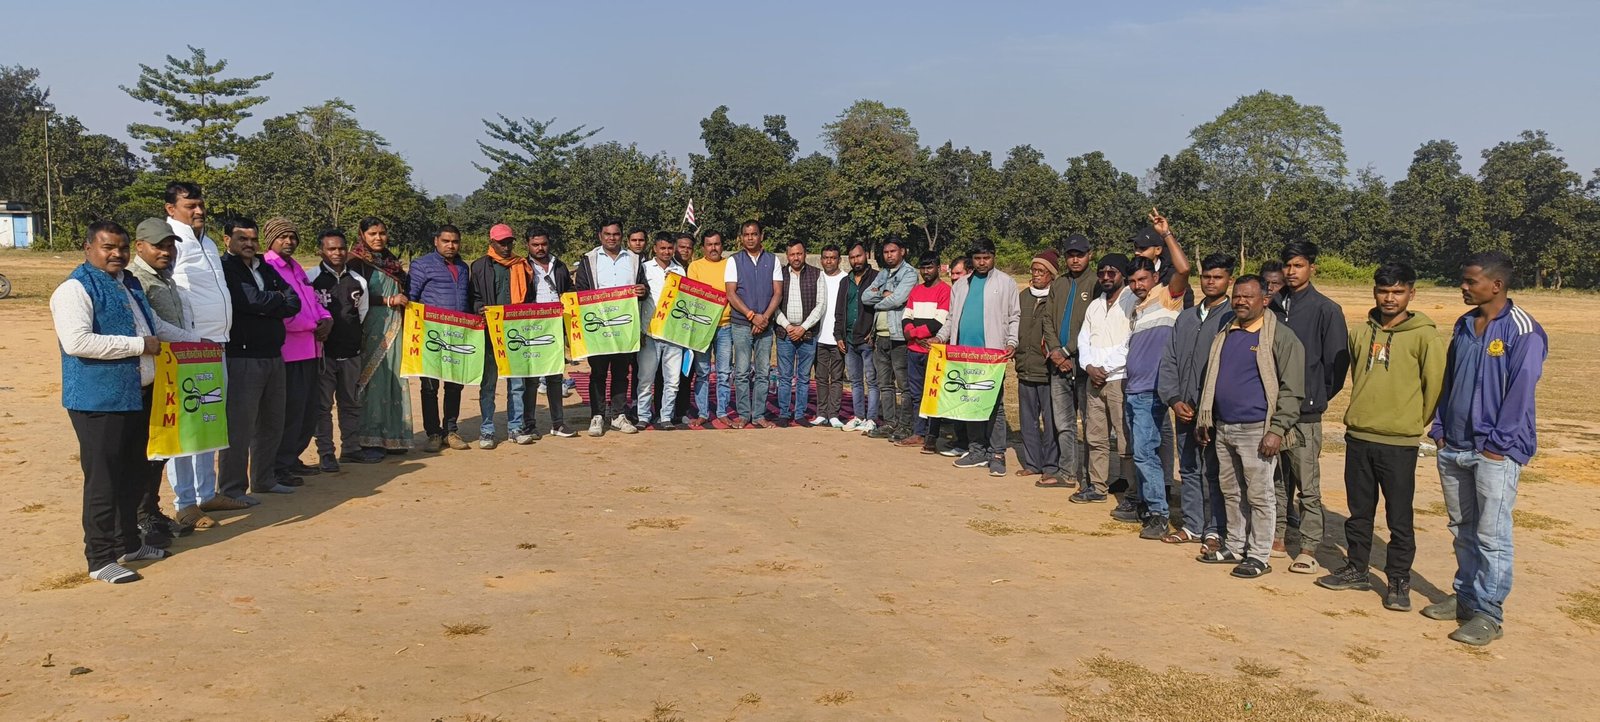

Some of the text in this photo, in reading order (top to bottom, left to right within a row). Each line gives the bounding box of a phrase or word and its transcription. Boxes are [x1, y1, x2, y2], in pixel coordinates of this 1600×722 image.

[569, 298, 582, 340] JLKM
[656, 280, 677, 320] JLKM
[409, 309, 421, 356] JLKM
[494, 312, 506, 358] JLKM
[163, 351, 176, 427] JLKM
[928, 350, 943, 397] JLKM
